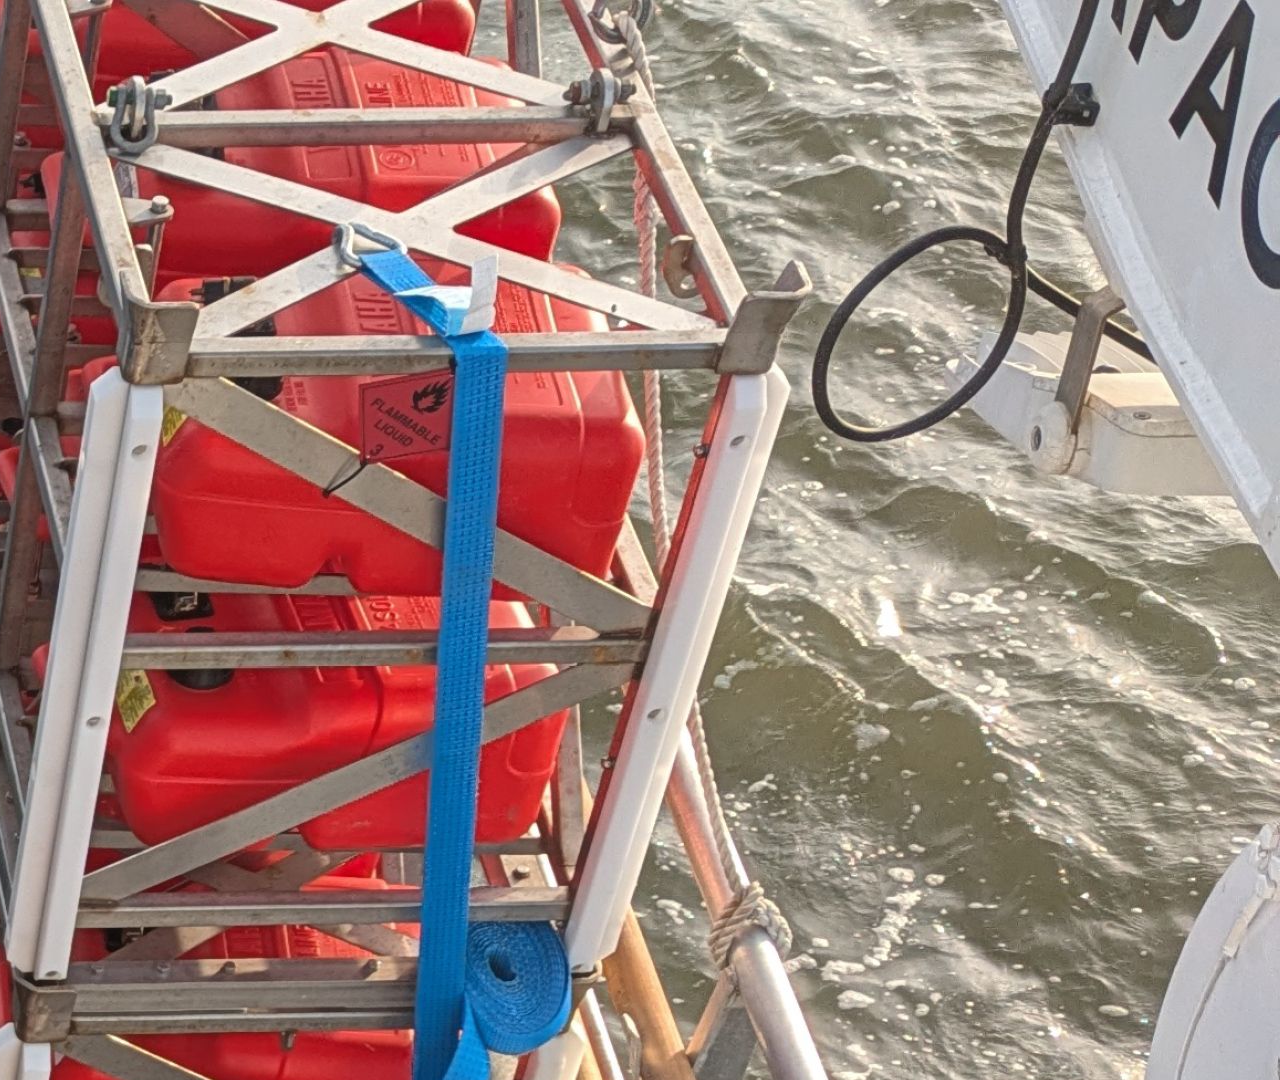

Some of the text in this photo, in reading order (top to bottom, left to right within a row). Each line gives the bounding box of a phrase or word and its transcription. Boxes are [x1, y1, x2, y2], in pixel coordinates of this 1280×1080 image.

[370, 397, 442, 446] FLAMMABLE
[374, 418, 414, 448] LIQUID
[369, 444, 383, 457] 3
